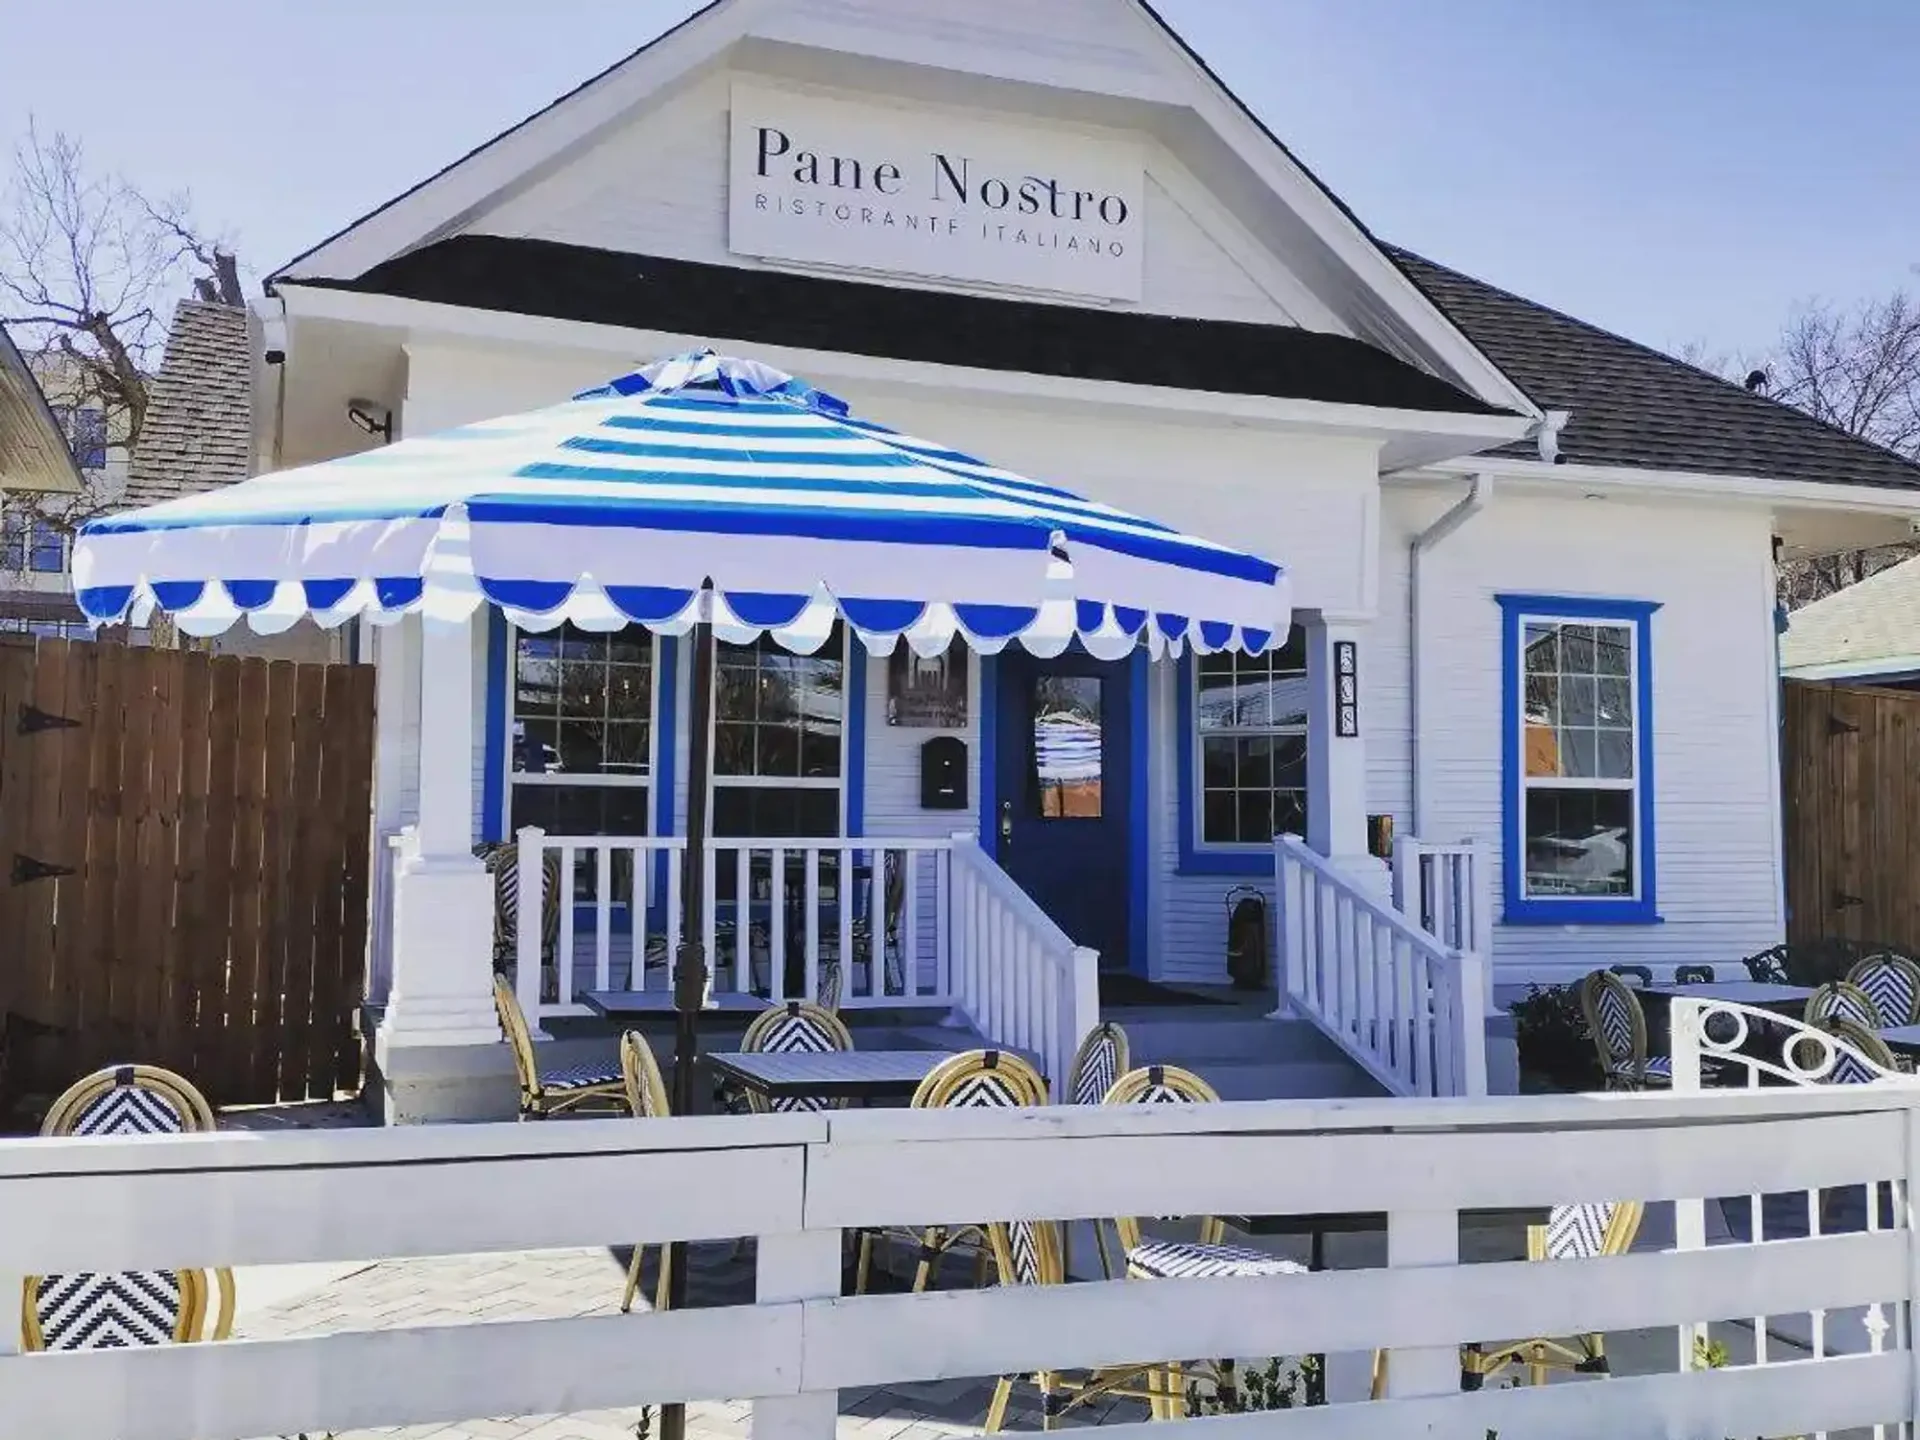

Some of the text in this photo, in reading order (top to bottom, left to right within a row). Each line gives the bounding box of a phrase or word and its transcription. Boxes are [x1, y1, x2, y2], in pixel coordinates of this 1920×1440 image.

[755, 125, 1129, 227] Pane Nostro
[754, 193, 1125, 258] RISTORANTE ITALIANO
